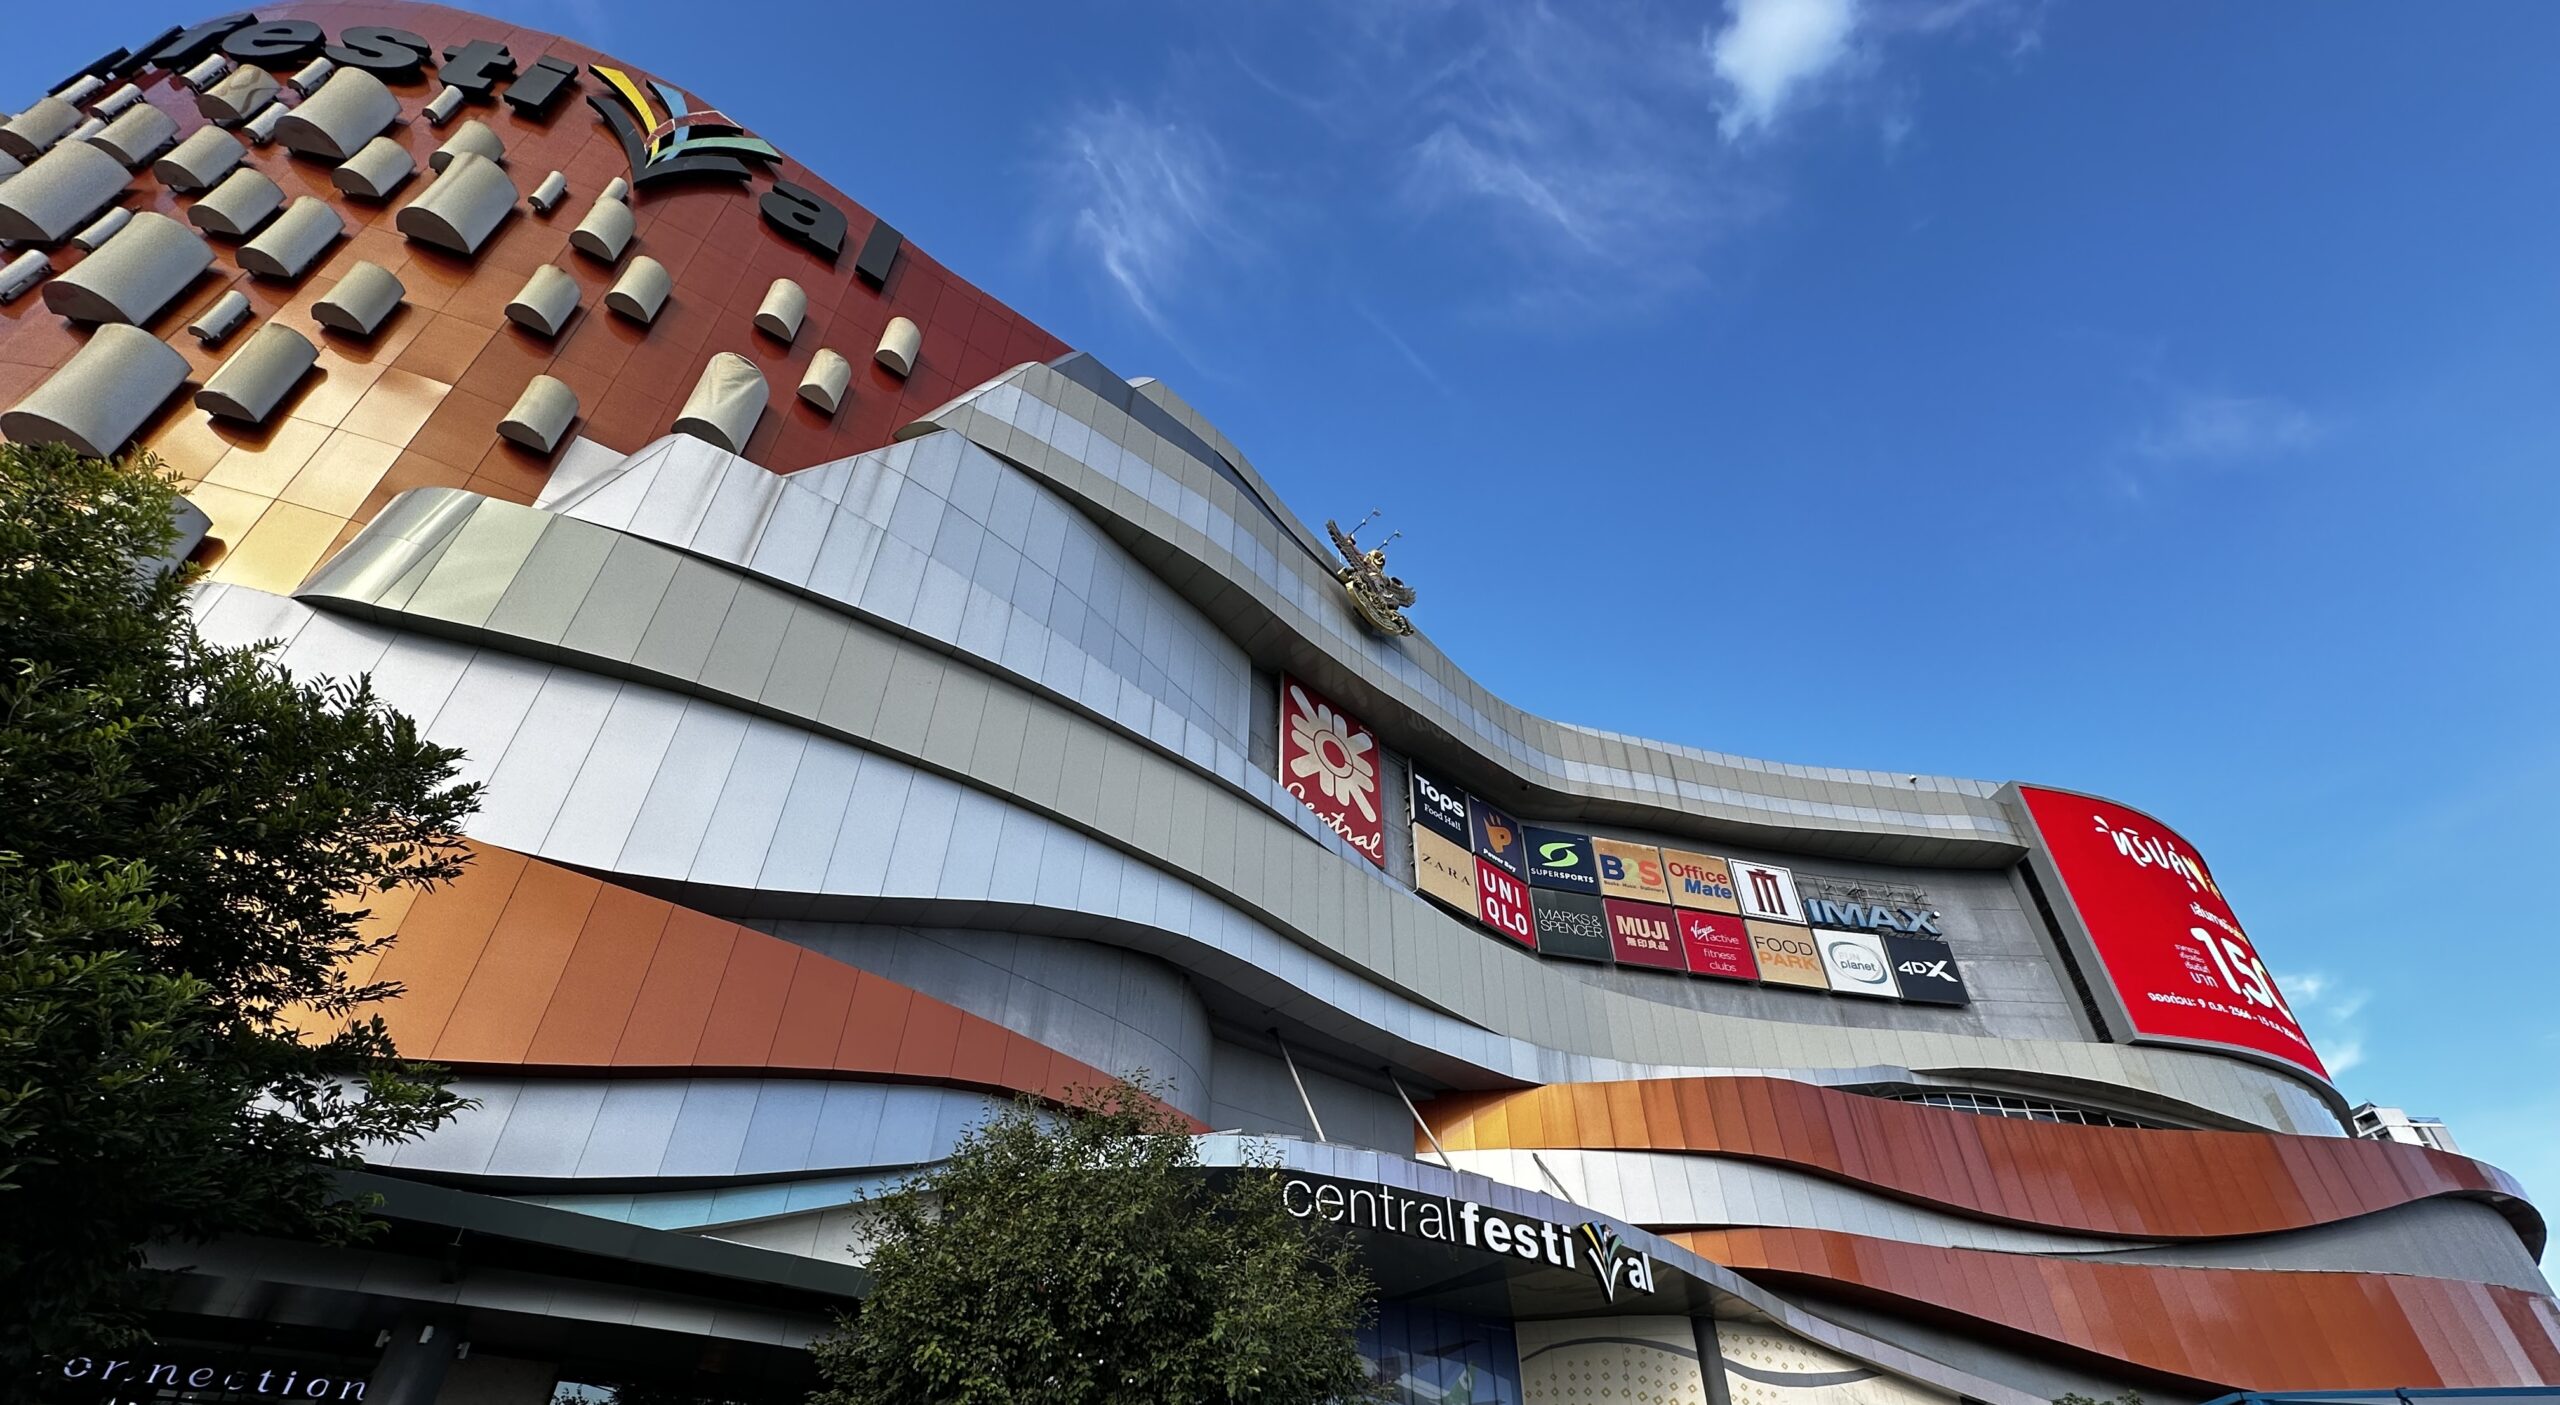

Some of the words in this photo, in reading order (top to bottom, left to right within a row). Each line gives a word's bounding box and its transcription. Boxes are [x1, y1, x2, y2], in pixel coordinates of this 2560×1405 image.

[1415, 773, 1465, 818] Tops
[1423, 803, 1443, 821] Food
[1444, 814, 1462, 832] Hall
[1422, 853, 1471, 887] ZARA
[1483, 848, 1503, 864] Power
[1503, 860, 1517, 873] Buy
[1599, 853, 1662, 886] B2S
[1530, 867, 1595, 884] SUPERSPORTS
[1668, 862, 1728, 885] Office
[1482, 868, 1522, 908] UNI
[1684, 878, 1733, 899] Mate
[1486, 897, 1529, 936] QLO
[1615, 914, 1670, 941] MUJI
[1805, 897, 1942, 937] IMAX
[1540, 919, 1605, 939] SPENCER
[1690, 920, 1715, 942] Virgin
[1709, 932, 1740, 945] active
[1625, 936, 1669, 951] 無印良品
[1703, 948, 1737, 961] fitness
[1753, 935, 1813, 956] FOOD
[1709, 960, 1737, 972] clubs
[1759, 950, 1819, 972] PARK
[1838, 951, 1860, 962] FUN
[1840, 959, 1877, 972] planet
[1898, 960, 1958, 983] 4DX
